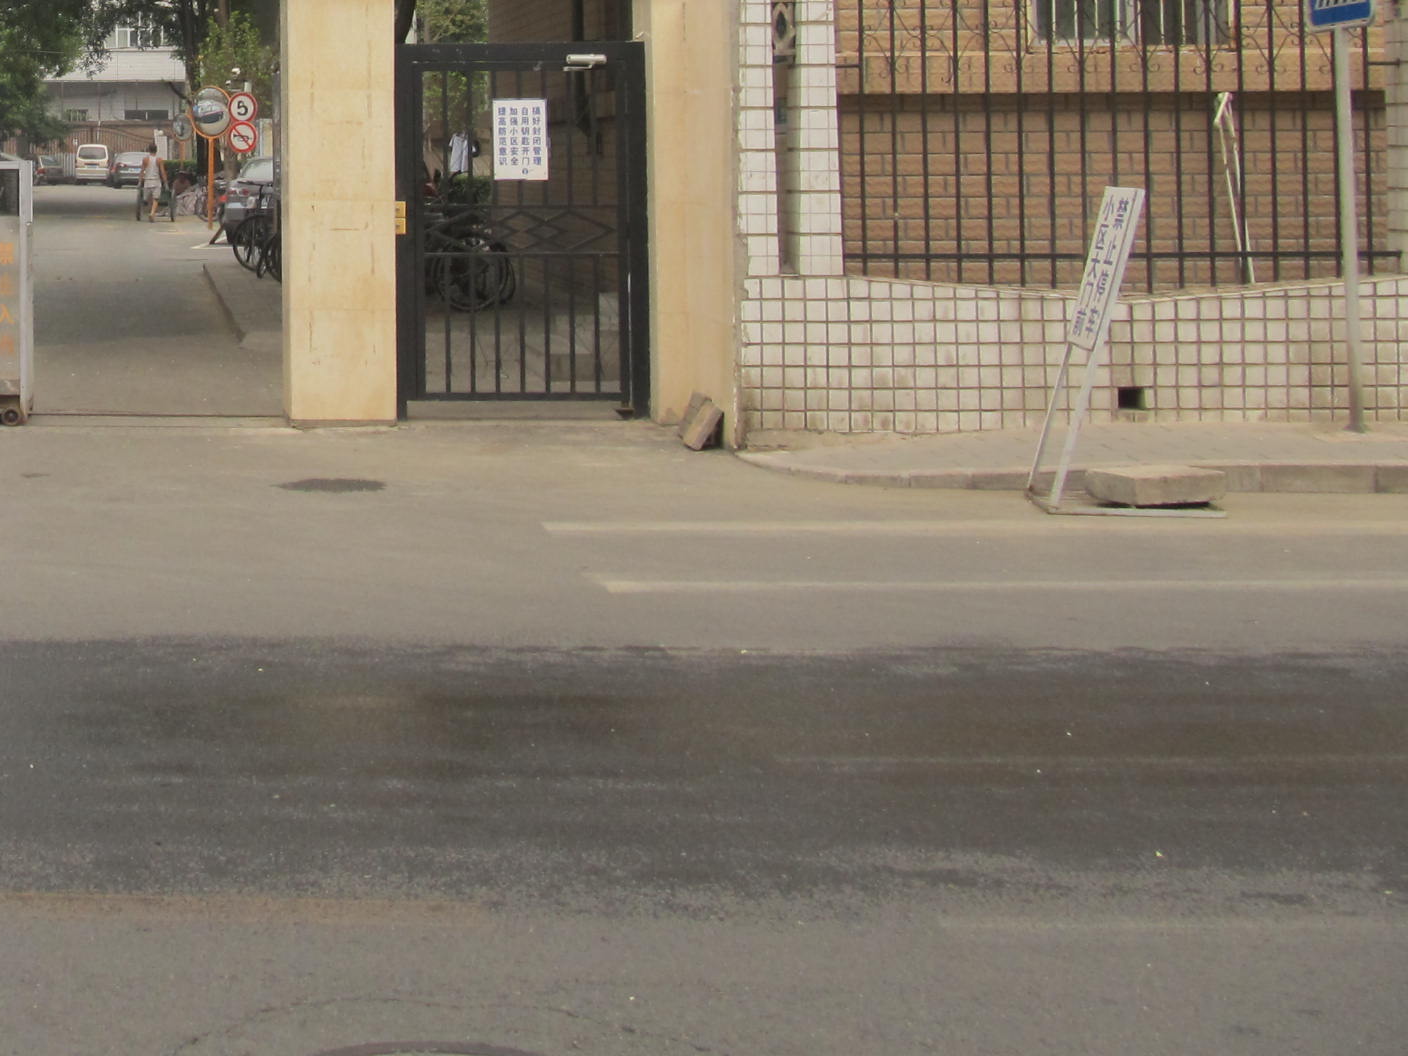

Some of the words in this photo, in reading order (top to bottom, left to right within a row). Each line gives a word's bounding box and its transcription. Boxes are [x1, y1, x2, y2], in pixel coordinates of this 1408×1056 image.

[237, 100, 249, 116] 5
[510, 107, 519, 166] 加强小区安全
[521, 107, 530, 166] 自用钥匙开门
[1085, 197, 1130, 339] 禁止停车
